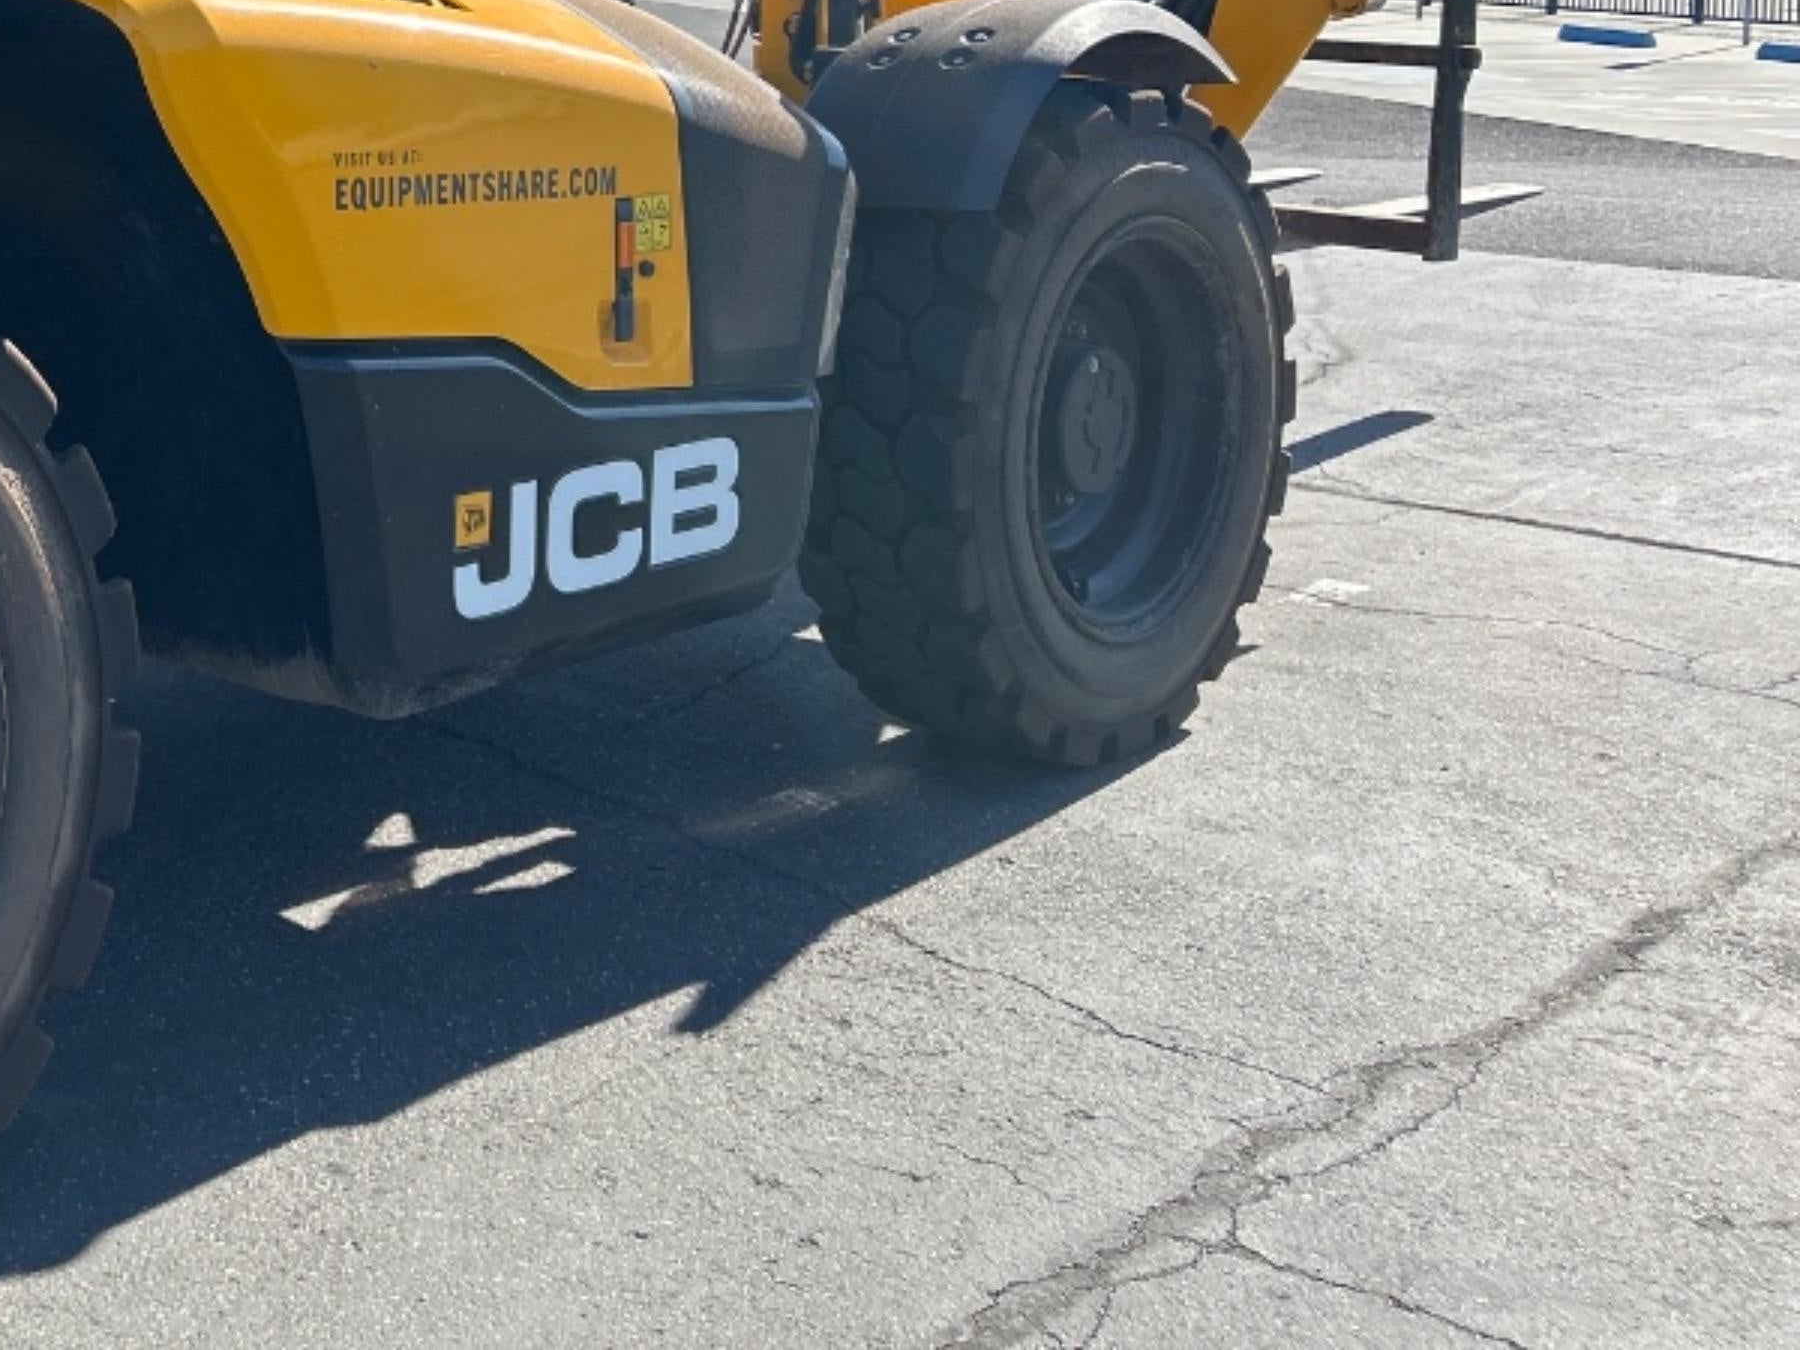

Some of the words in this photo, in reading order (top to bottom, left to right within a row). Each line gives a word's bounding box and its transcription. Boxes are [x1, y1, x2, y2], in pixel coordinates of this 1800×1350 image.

[333, 151, 372, 167] VISIT
[334, 166, 617, 211] EQUIPMENTSHARE.COM
[453, 436, 740, 620] JCB
